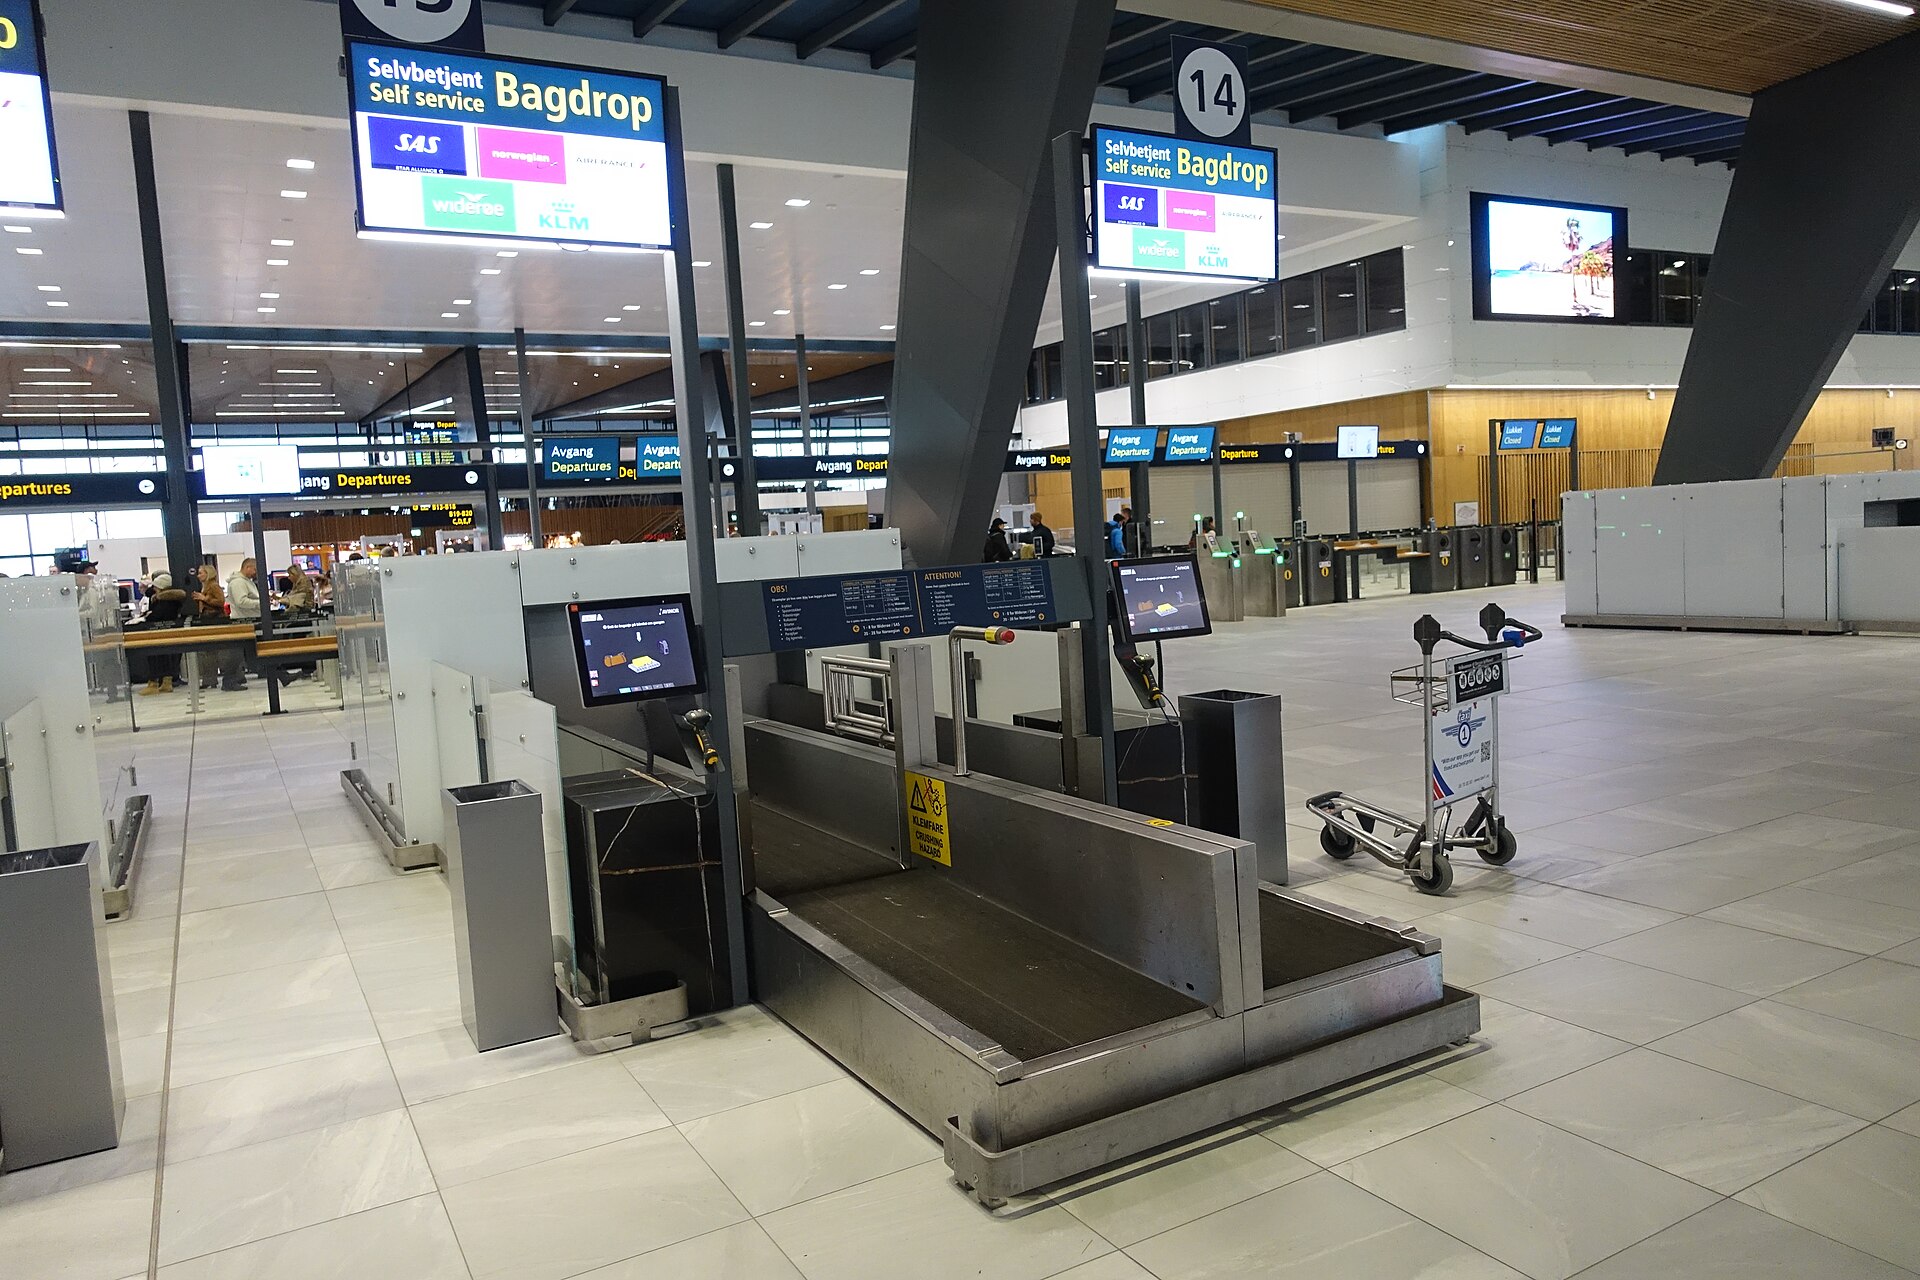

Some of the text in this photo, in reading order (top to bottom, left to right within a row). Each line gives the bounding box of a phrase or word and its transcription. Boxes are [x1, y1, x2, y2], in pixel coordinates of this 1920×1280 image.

[367, 57, 484, 90] Selvbetjent
[369, 82, 485, 113] Self service
[1190, 69, 1237, 116] 14
[494, 71, 653, 132] Bagdrop
[394, 133, 442, 154] SAS
[491, 149, 551, 163] norwegian
[1105, 139, 1171, 163] Selvbetjent
[1105, 157, 1171, 179] Self service
[1177, 147, 1268, 191] Bagdrop
[1117, 195, 1146, 211] SAS
[538, 214, 590, 230] KLM
[1198, 255, 1229, 268] KLM
[413, 420, 457, 430] Avgang Depart
[1505, 426, 1523, 434] Lukket
[1545, 425, 1563, 433] Lukket
[1112, 434, 1141, 446] Avgang
[1171, 433, 1198, 445] Avgang
[1503, 436, 1522, 445] Closed
[1543, 435, 1561, 443] Closed
[551, 445, 594, 459] Avgang
[1110, 447, 1150, 458] Departures
[1169, 445, 1207, 457] Departures
[1220, 449, 1258, 460] Departures
[1377, 445, 1395, 454] rtures
[551, 461, 612, 475] Departures
[643, 459, 682, 473] Depart
[815, 459, 888, 474] Avgang Depart
[1015, 455, 1047, 467] Avgang
[337, 473, 412, 490] Departures
[0, 482, 72, 500] partures
[924, 571, 962, 581] ATTENTION!
[770, 585, 788, 594] OBS!
[1461, 726, 1468, 741] 1
[912, 815, 944, 835] KLEMFARE
[915, 830, 944, 849] CRUSHING
[918, 842, 941, 859] HAZARD
